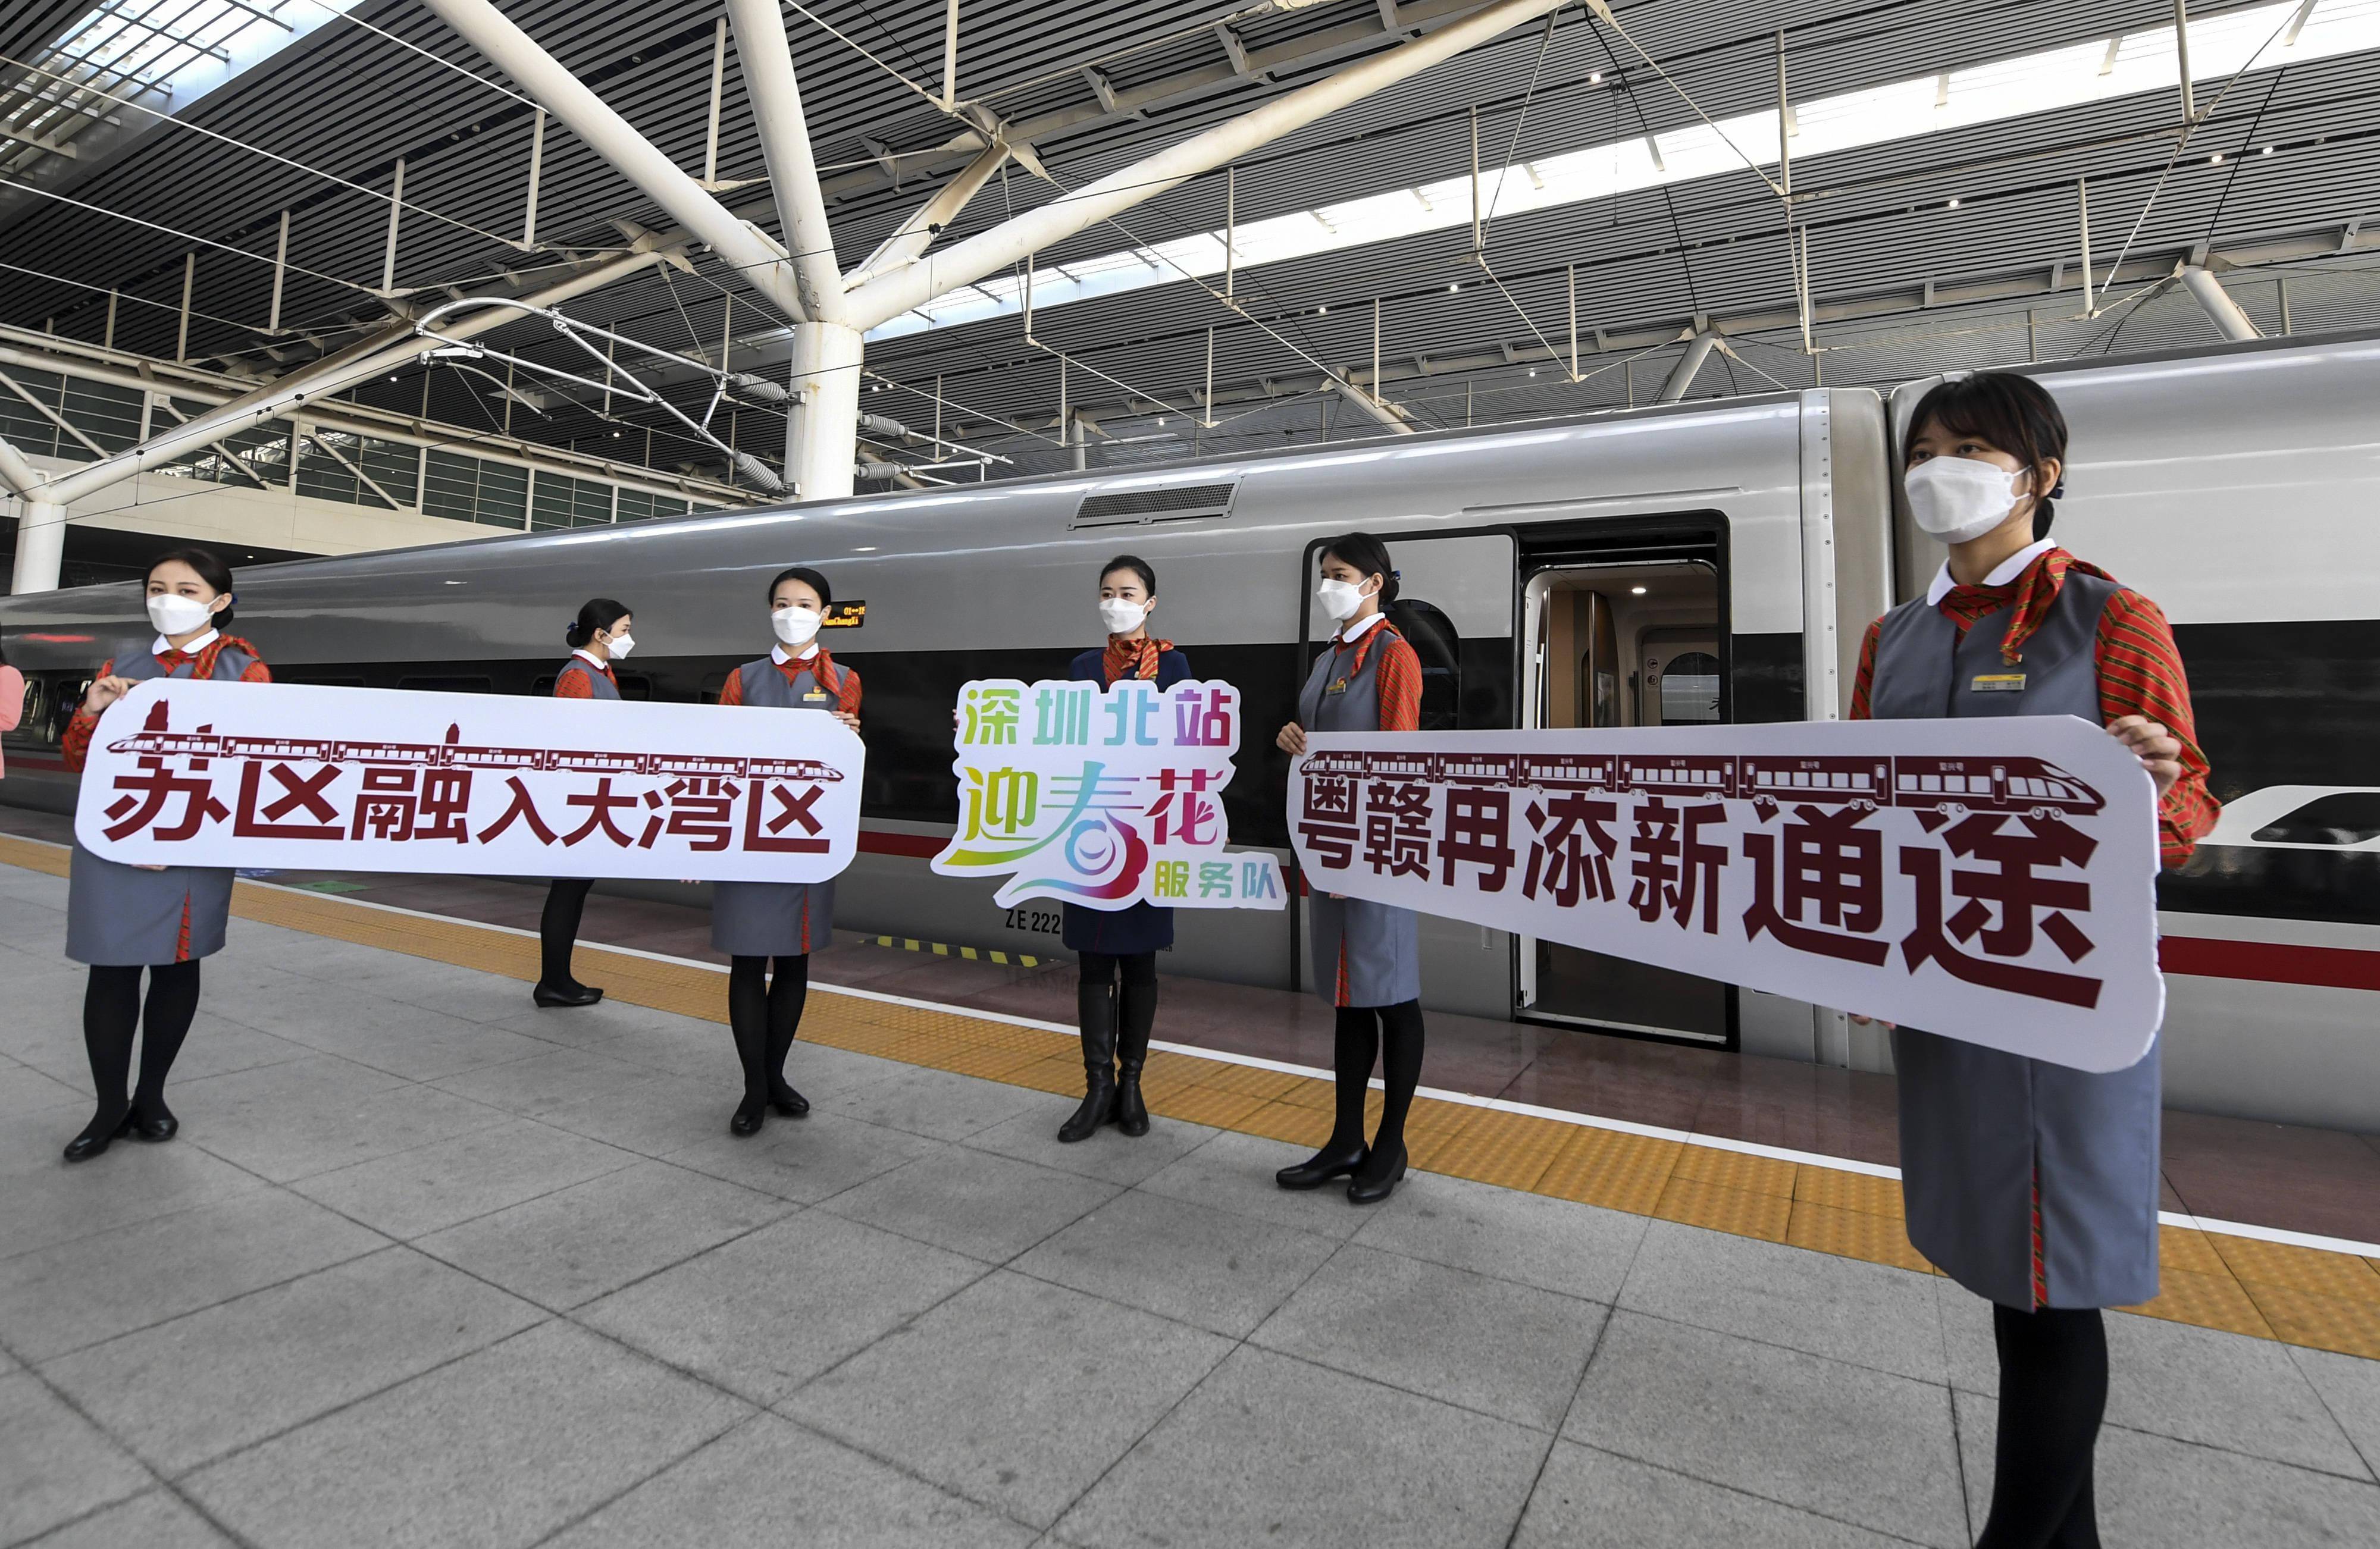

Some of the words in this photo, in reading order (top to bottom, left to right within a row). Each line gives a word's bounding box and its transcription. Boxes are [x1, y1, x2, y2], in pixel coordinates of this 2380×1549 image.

[963, 688, 1232, 747] 深圳北站
[102, 756, 831, 854] 苏区融入大湾区
[942, 760, 1225, 899] 迎春花
[1154, 861, 1277, 899] 服务队
